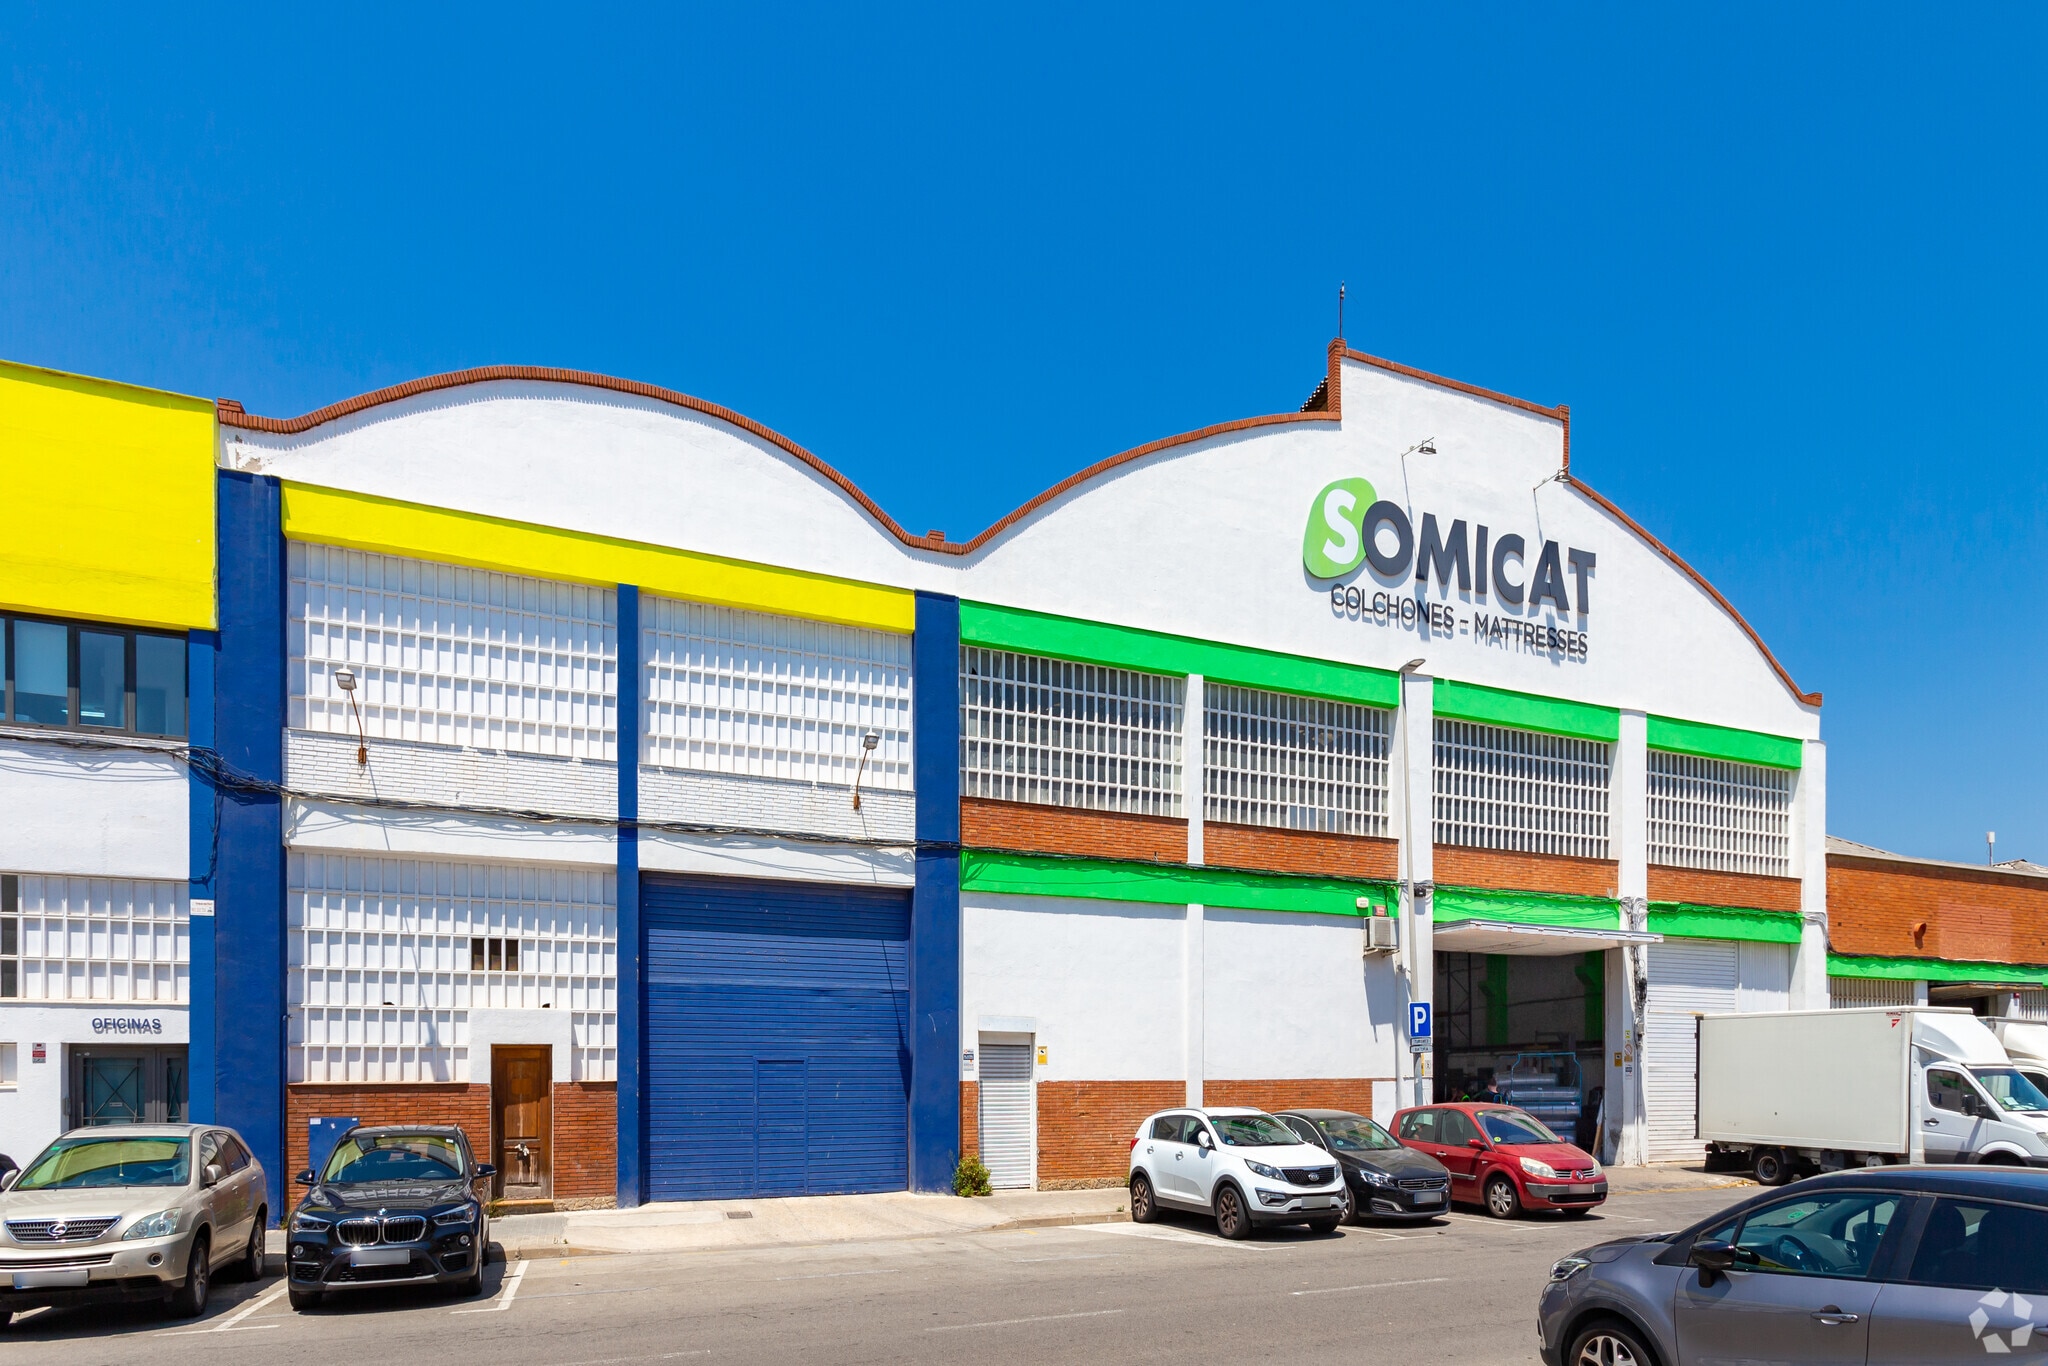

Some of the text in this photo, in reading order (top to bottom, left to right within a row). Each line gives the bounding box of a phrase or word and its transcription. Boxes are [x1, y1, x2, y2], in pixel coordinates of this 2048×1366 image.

[1323, 488, 1596, 614] SOMICAT
[1331, 583, 1454, 629] COLCHONES
[1474, 611, 1588, 655] MATTRESSES
[92, 1017, 162, 1030] OFICINAS
[1413, 1006, 1427, 1034] P
